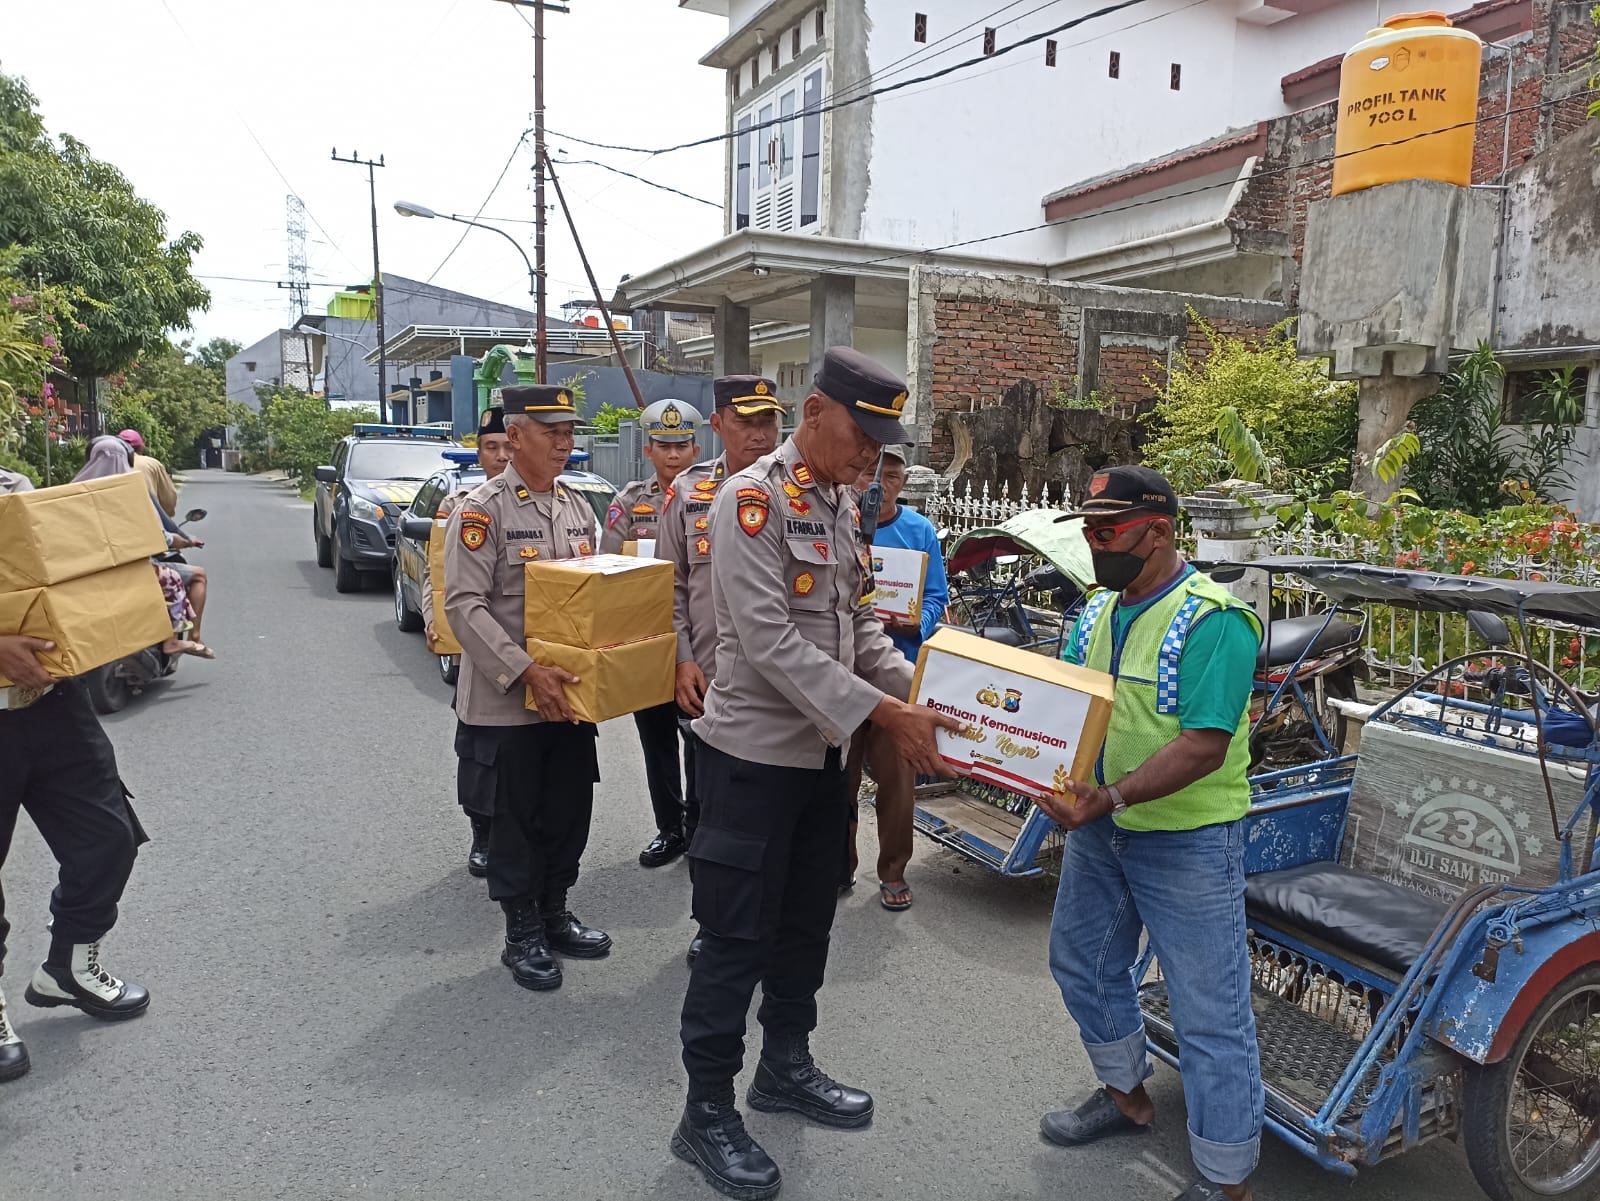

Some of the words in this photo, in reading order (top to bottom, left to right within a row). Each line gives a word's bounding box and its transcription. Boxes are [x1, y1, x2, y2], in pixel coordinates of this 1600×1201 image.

[1347, 92, 1396, 117] PROFIL
[1399, 88, 1447, 102] TANK
[926, 697, 977, 723] Bantuan
[980, 714, 1068, 750] Kemanusiaan
[943, 722, 988, 744] tuk
[1420, 810, 1506, 859] 234
[1409, 848, 1436, 871] DJI
[1439, 857, 1475, 882] SAM
